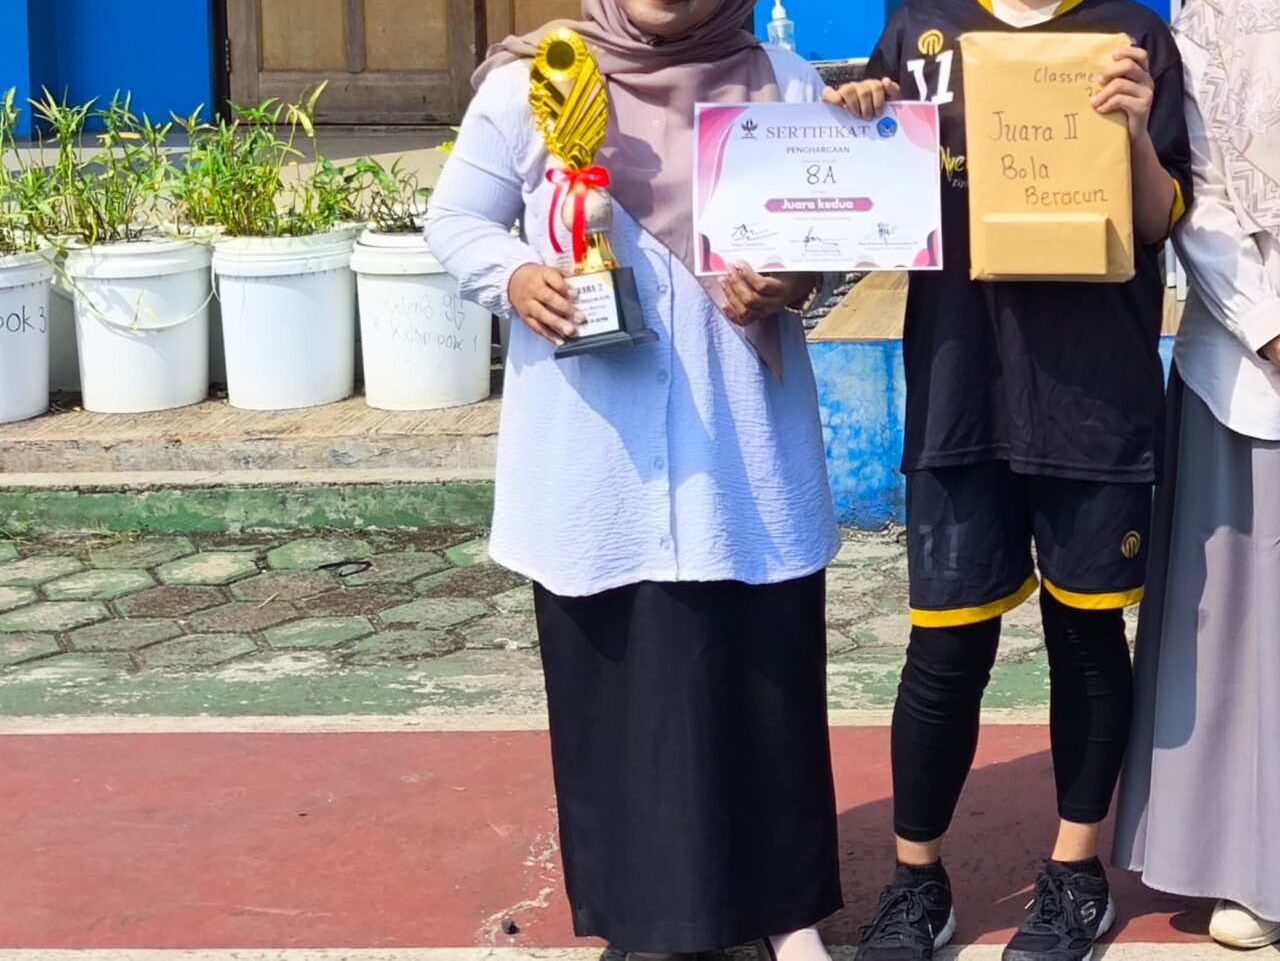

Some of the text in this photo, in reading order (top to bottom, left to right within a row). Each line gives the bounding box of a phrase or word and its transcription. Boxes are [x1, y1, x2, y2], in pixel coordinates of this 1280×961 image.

[1034, 68, 1095, 83] Classme
[766, 126, 871, 139] SERTIFIKAT
[988, 111, 1080, 142] Juara II
[786, 146, 850, 154] PENGHARGAAN
[1001, 154, 1050, 180] Bola
[782, 198, 854, 209] Juara kedua
[1025, 186, 1108, 206] Beracun
[38, 306, 47, 333] 3
